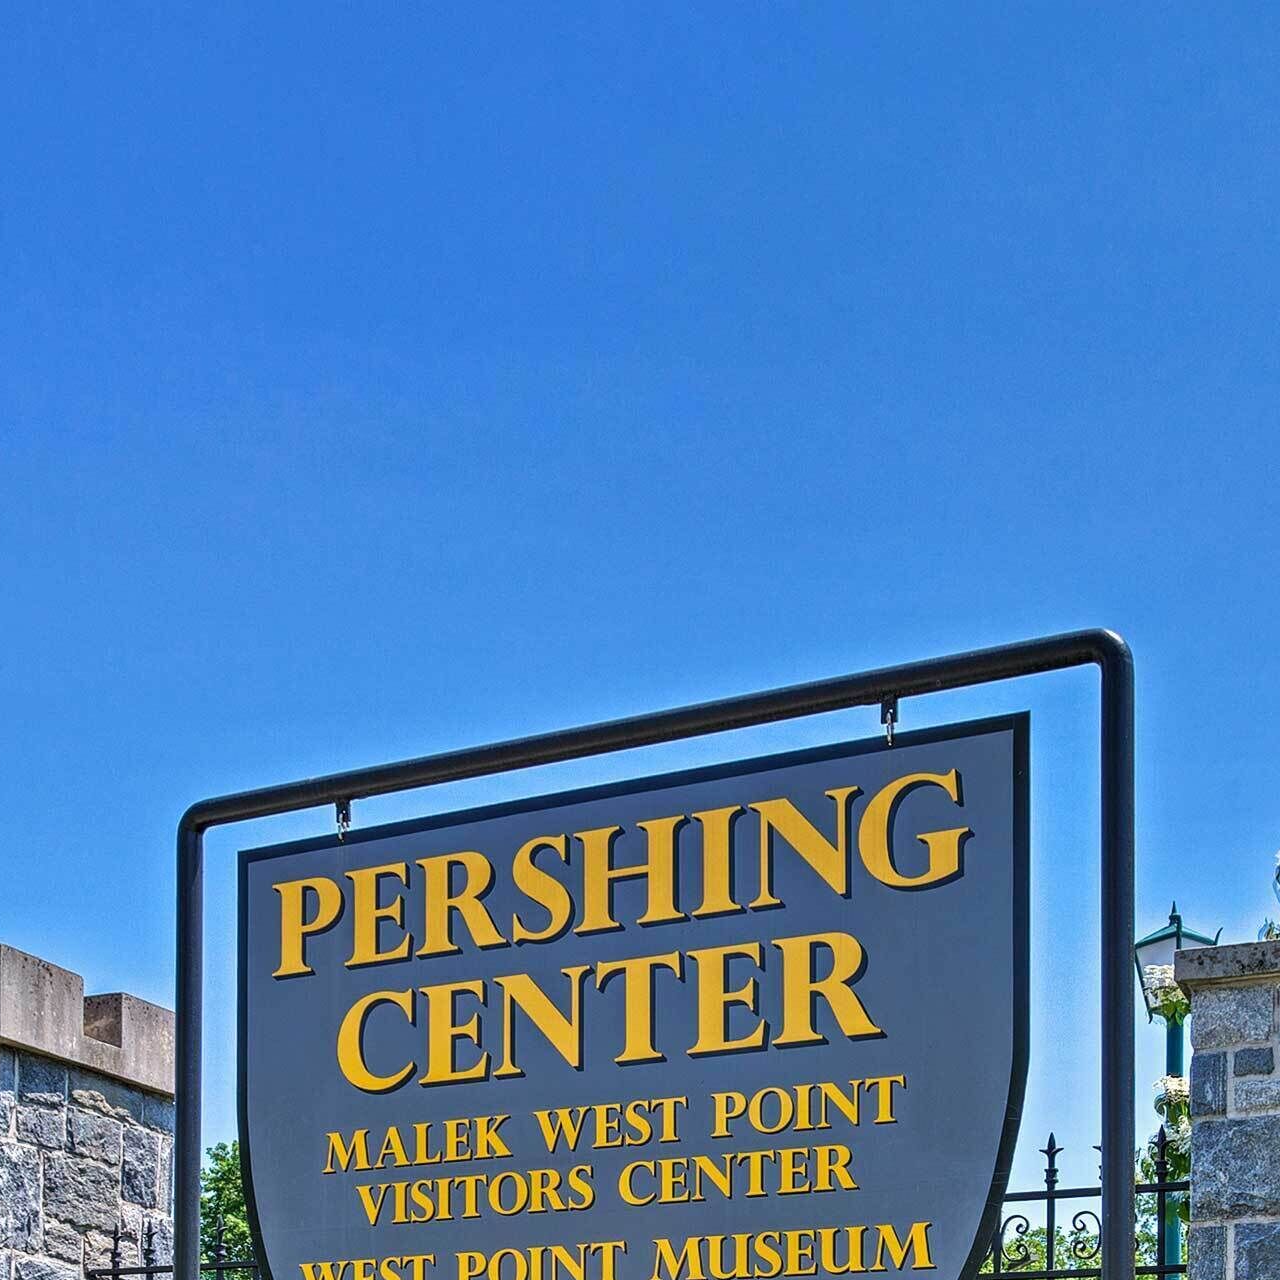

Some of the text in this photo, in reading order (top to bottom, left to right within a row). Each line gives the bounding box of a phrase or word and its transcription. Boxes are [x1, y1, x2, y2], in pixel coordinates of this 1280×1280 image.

[272, 768, 972, 978] PERSHING
[336, 931, 882, 1094] CENTER
[323, 1075, 905, 1174] MALEK WEST POINT
[356, 1144, 858, 1226] VISITORS CENTER
